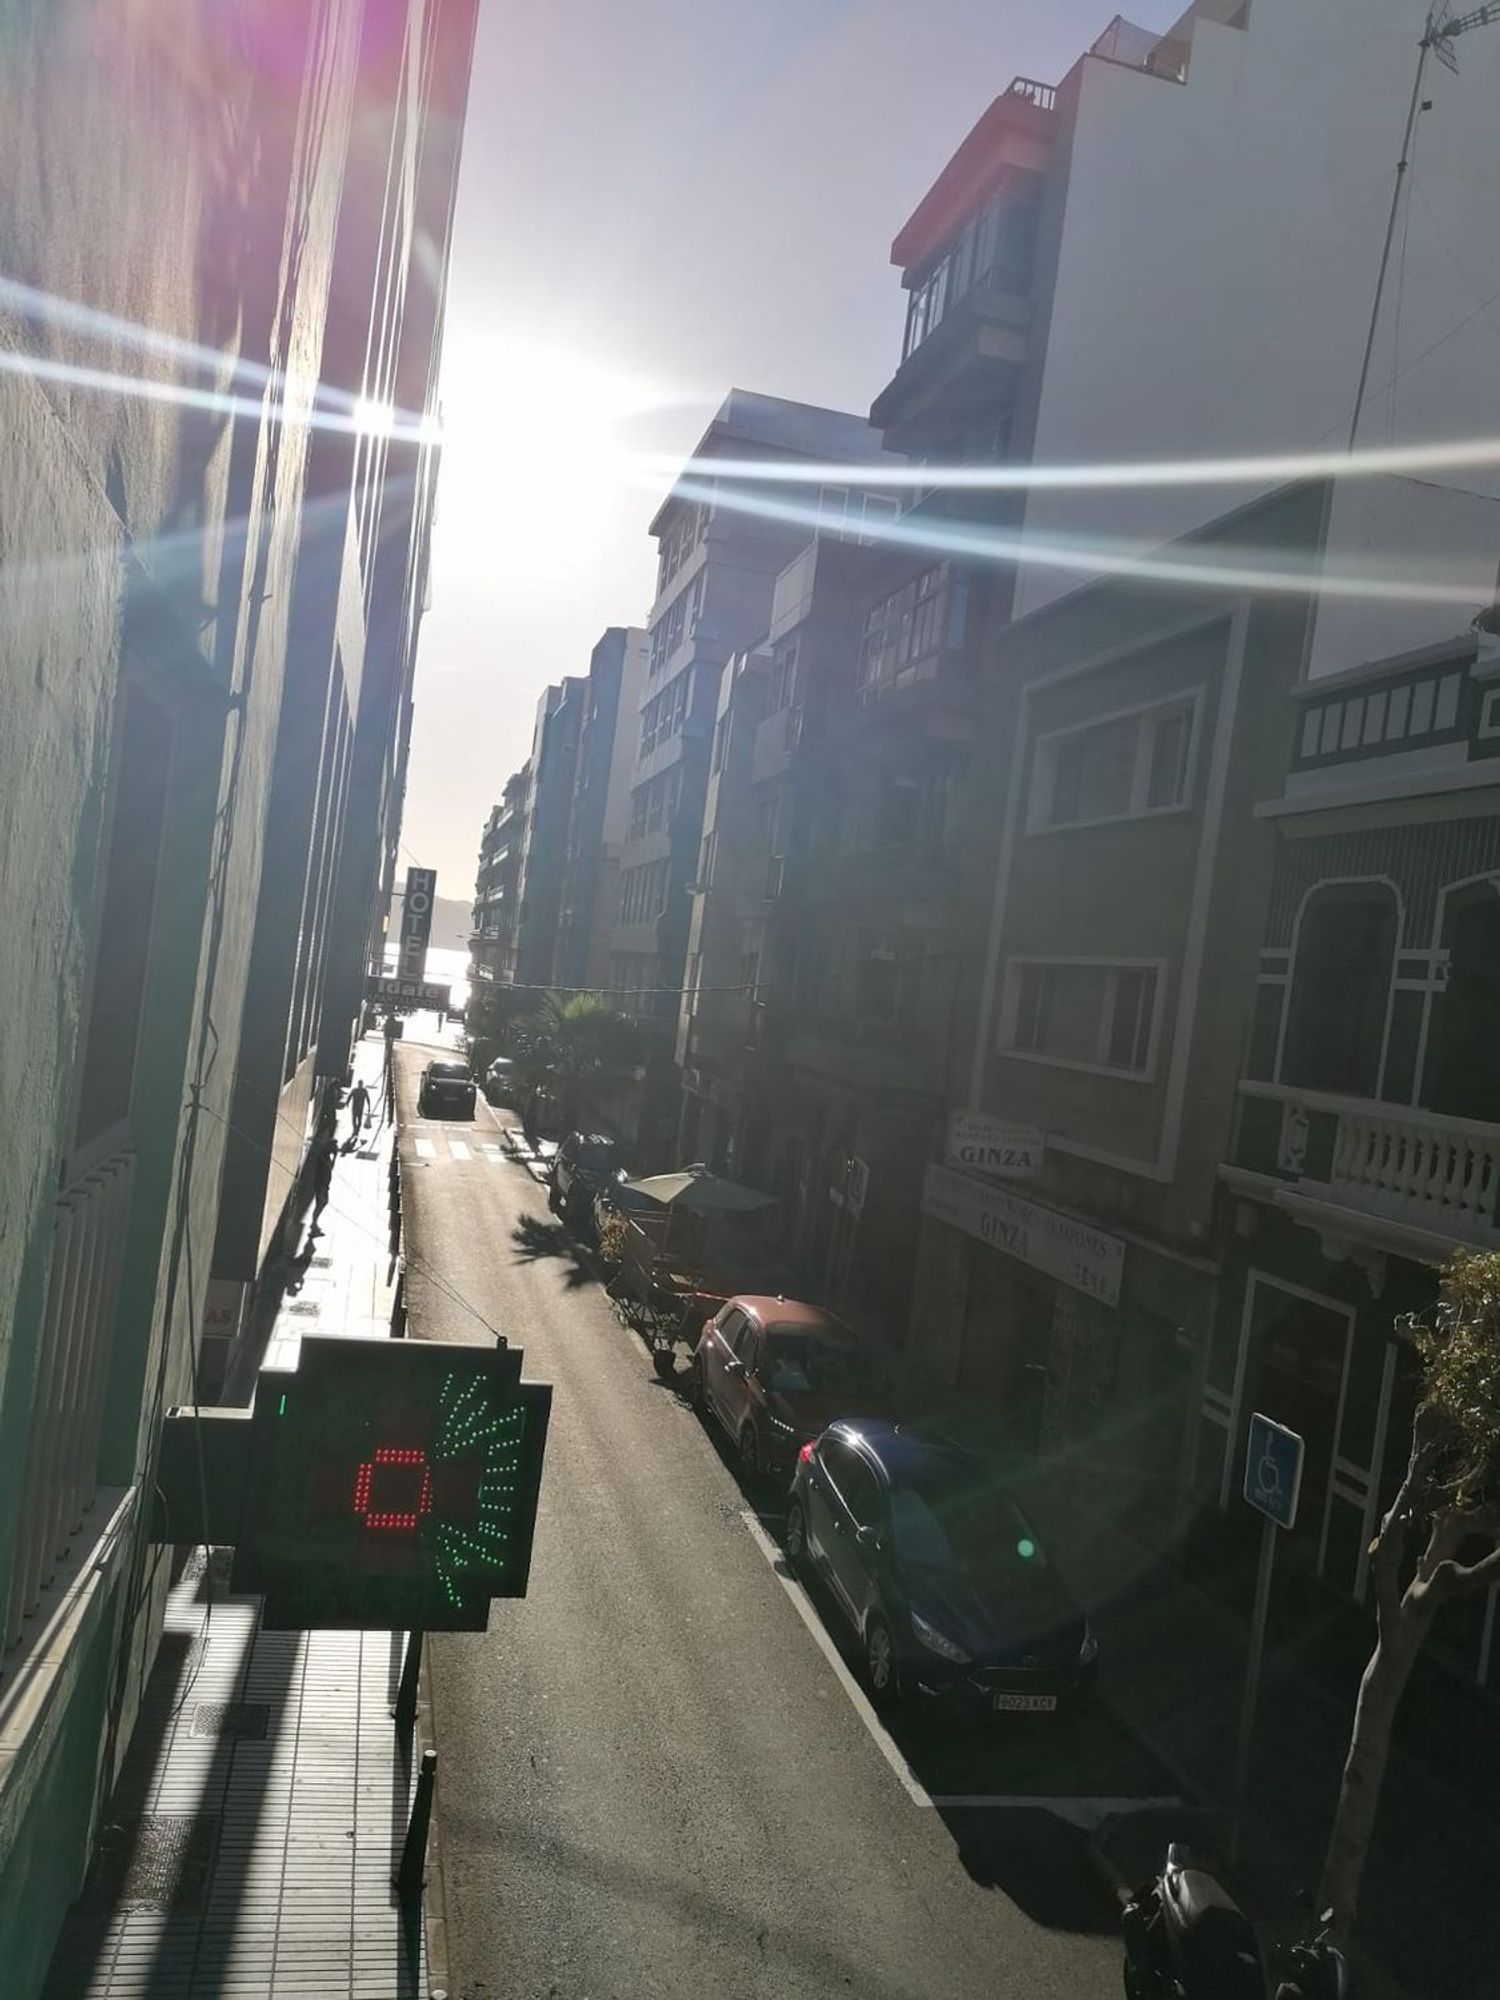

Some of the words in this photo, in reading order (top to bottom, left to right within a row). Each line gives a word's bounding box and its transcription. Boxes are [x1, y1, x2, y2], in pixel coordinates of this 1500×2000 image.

[405, 871, 430, 978] HOTEL
[378, 979, 440, 998] Idafe
[960, 1146, 1031, 1167] GINZA
[980, 1212, 1029, 1258] GINZA
